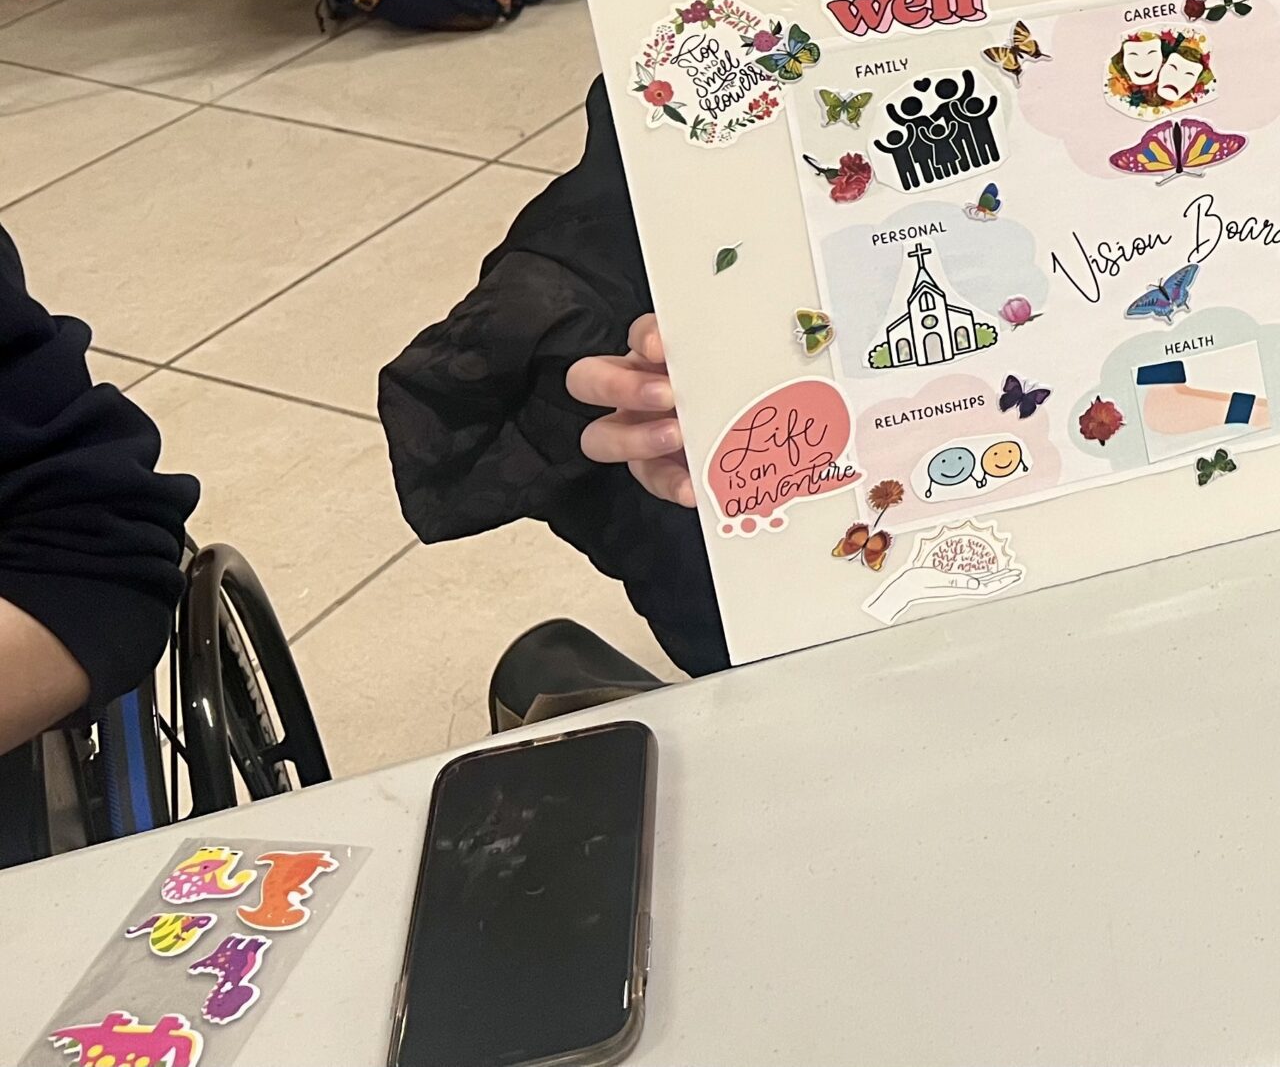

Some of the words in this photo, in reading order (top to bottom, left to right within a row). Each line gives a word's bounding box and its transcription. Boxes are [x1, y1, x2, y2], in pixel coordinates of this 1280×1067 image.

[1124, 2, 1178, 23] CAREER
[670, 33, 720, 78] Stop
[699, 59, 719, 77] AND
[855, 57, 909, 79] FAMILY
[692, 49, 741, 99] Smell
[871, 221, 948, 246] PERSONAL
[1051, 231, 1173, 303] Vision
[1164, 334, 1215, 356] HEALTH
[874, 395, 986, 430] RELATIONSHIPS
[719, 406, 828, 473] Life
[725, 451, 856, 518] adventure
[729, 470, 747, 490] is
[750, 462, 777, 481] an
